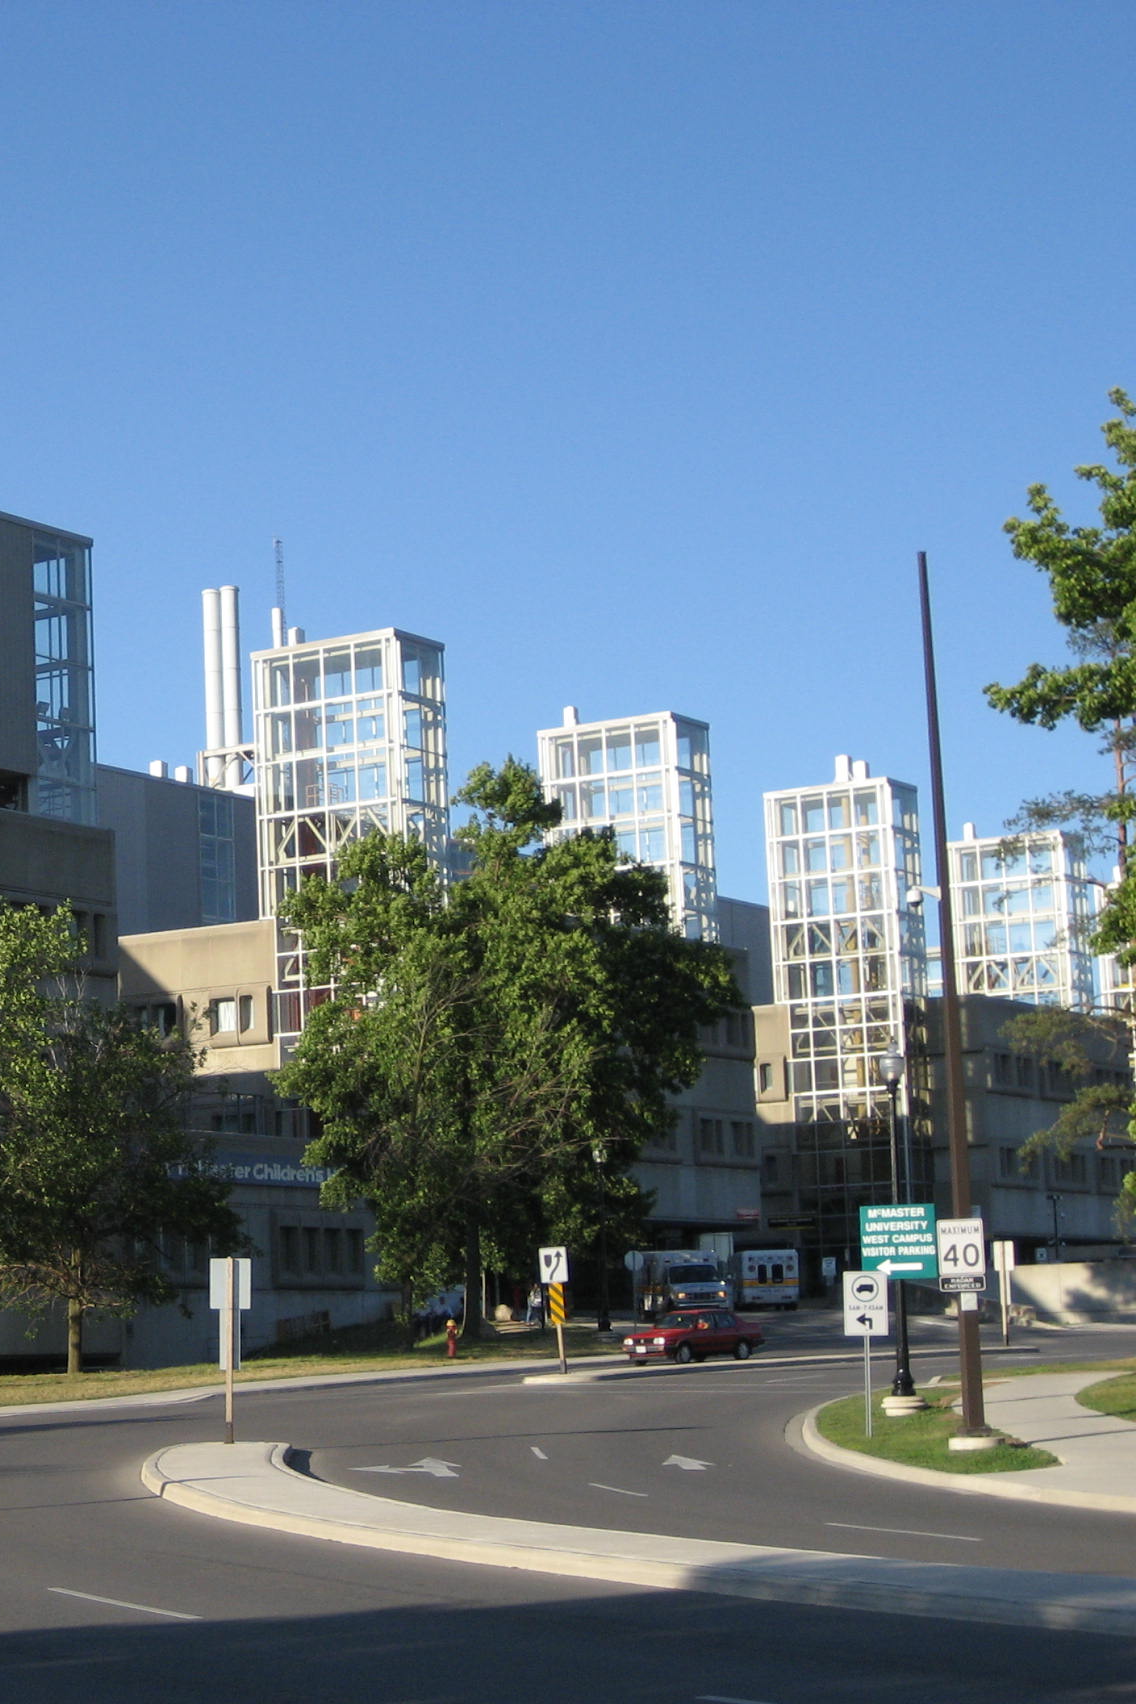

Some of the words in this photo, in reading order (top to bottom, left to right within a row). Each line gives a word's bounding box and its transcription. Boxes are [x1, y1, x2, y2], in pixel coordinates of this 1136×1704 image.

[253, 1163, 324, 1182] Children's
[865, 1221, 928, 1231] UNIVERSITY
[862, 1235, 889, 1244] WEST
[892, 1233, 933, 1243] CAMPUS
[862, 1246, 896, 1257] VISITOR
[898, 1245, 936, 1255] PARKING
[944, 1243, 979, 1267] 40
